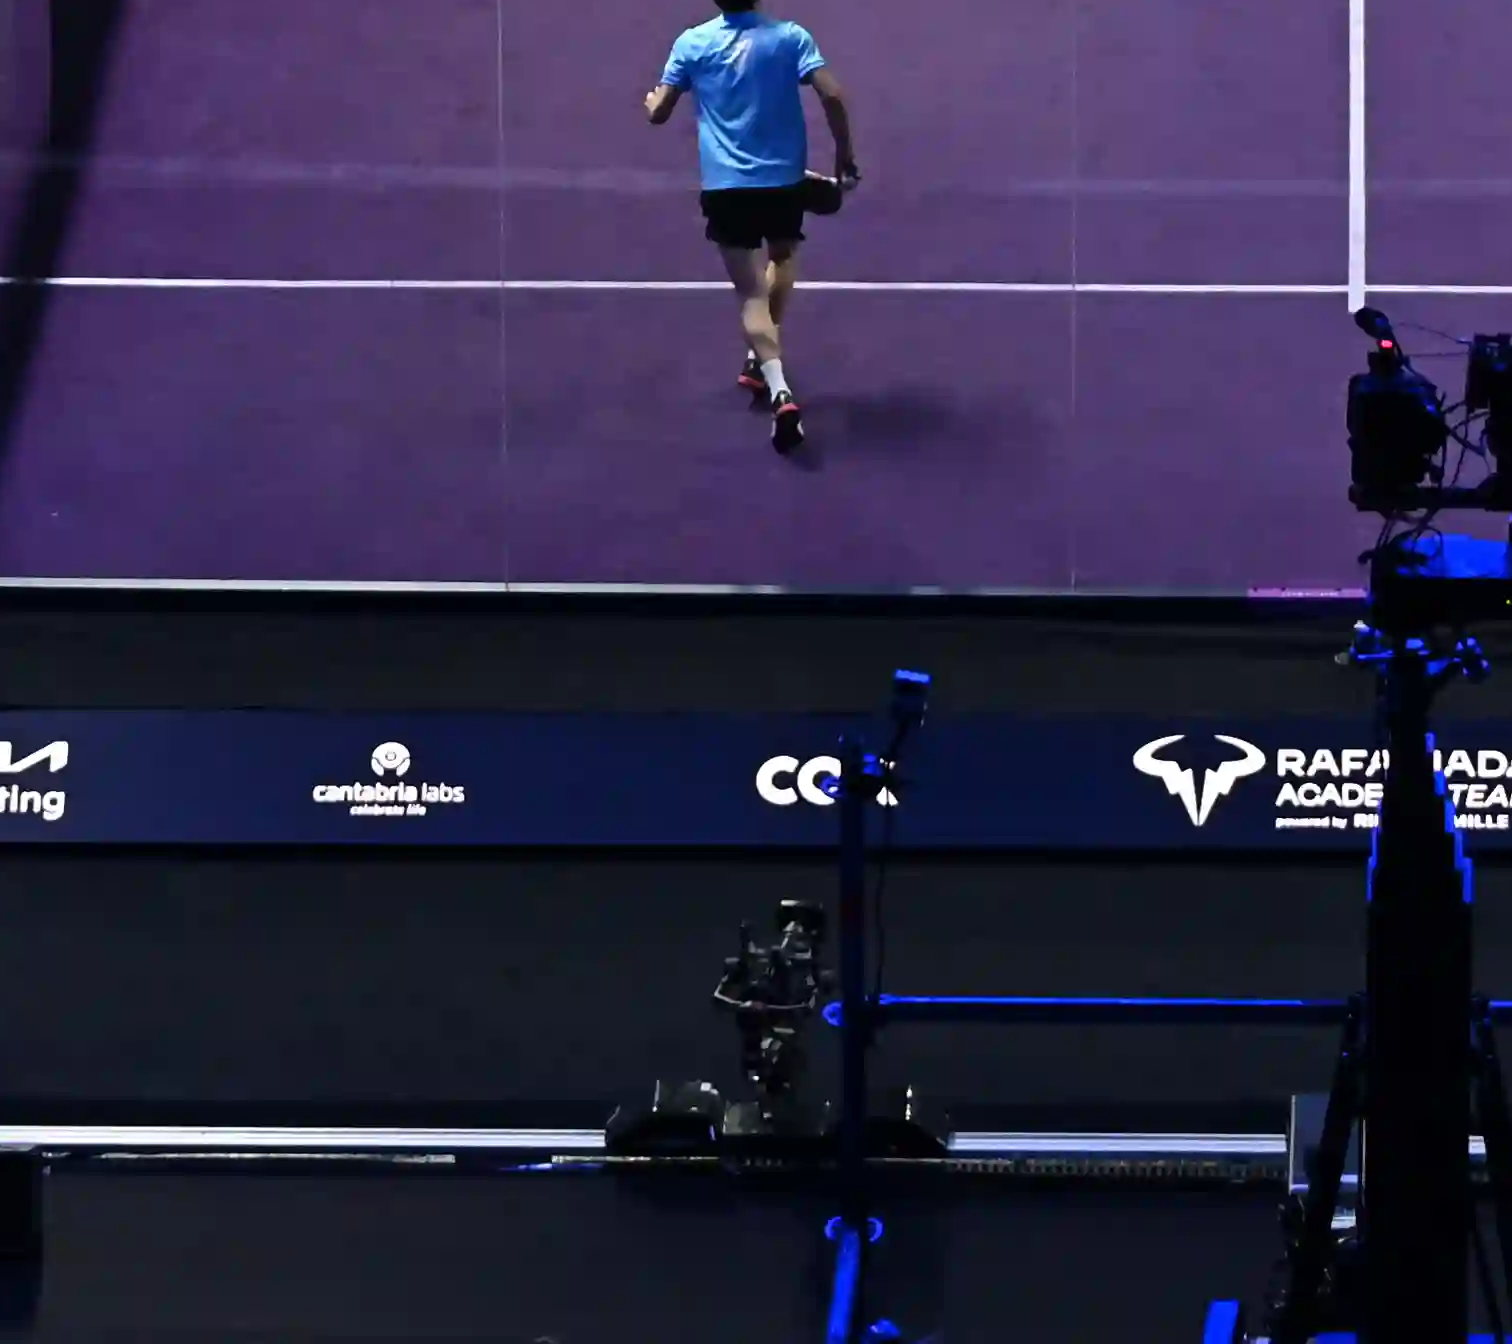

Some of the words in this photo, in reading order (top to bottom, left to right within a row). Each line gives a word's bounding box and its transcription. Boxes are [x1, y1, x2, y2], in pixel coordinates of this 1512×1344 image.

[1277, 748, 1390, 778] RAFA
[312, 781, 419, 802] cantabria
[421, 781, 465, 802] labs
[1275, 782, 1384, 808] ACADE
